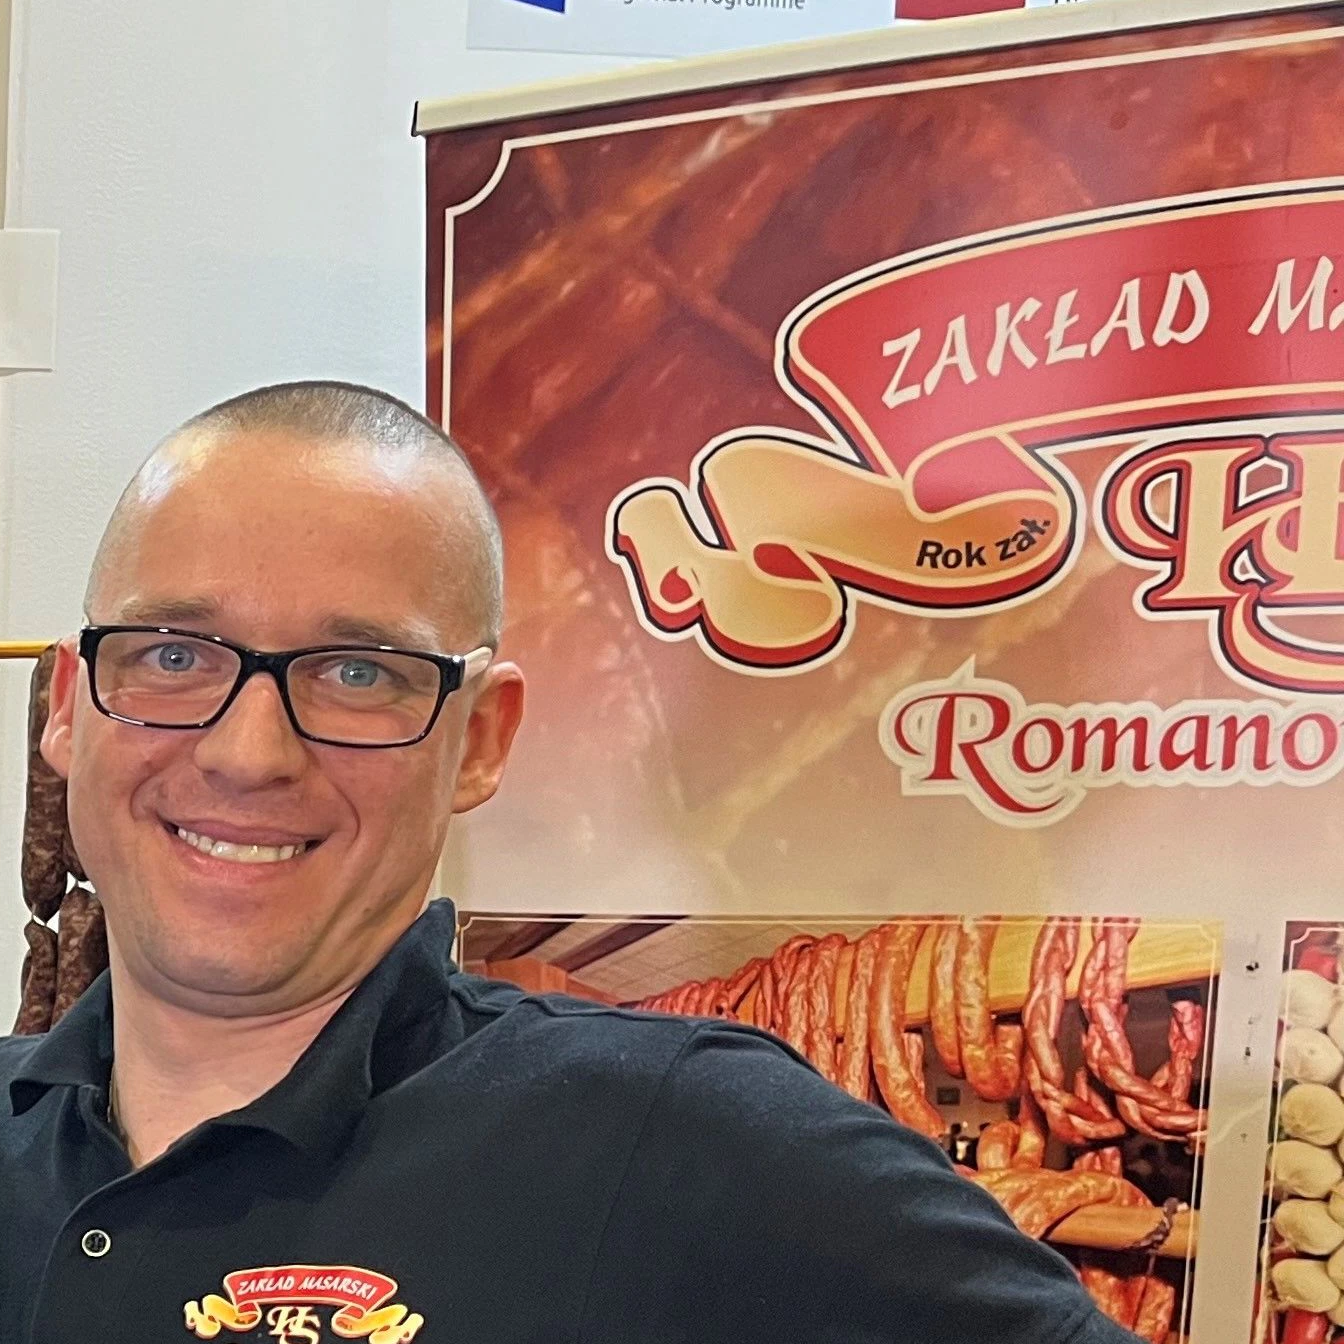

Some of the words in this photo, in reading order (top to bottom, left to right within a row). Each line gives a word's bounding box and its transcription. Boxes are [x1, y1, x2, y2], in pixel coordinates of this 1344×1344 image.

[880, 268, 1210, 410] ZAKŁAD
[916, 540, 987, 569] Rok
[894, 690, 1344, 815] Romano
